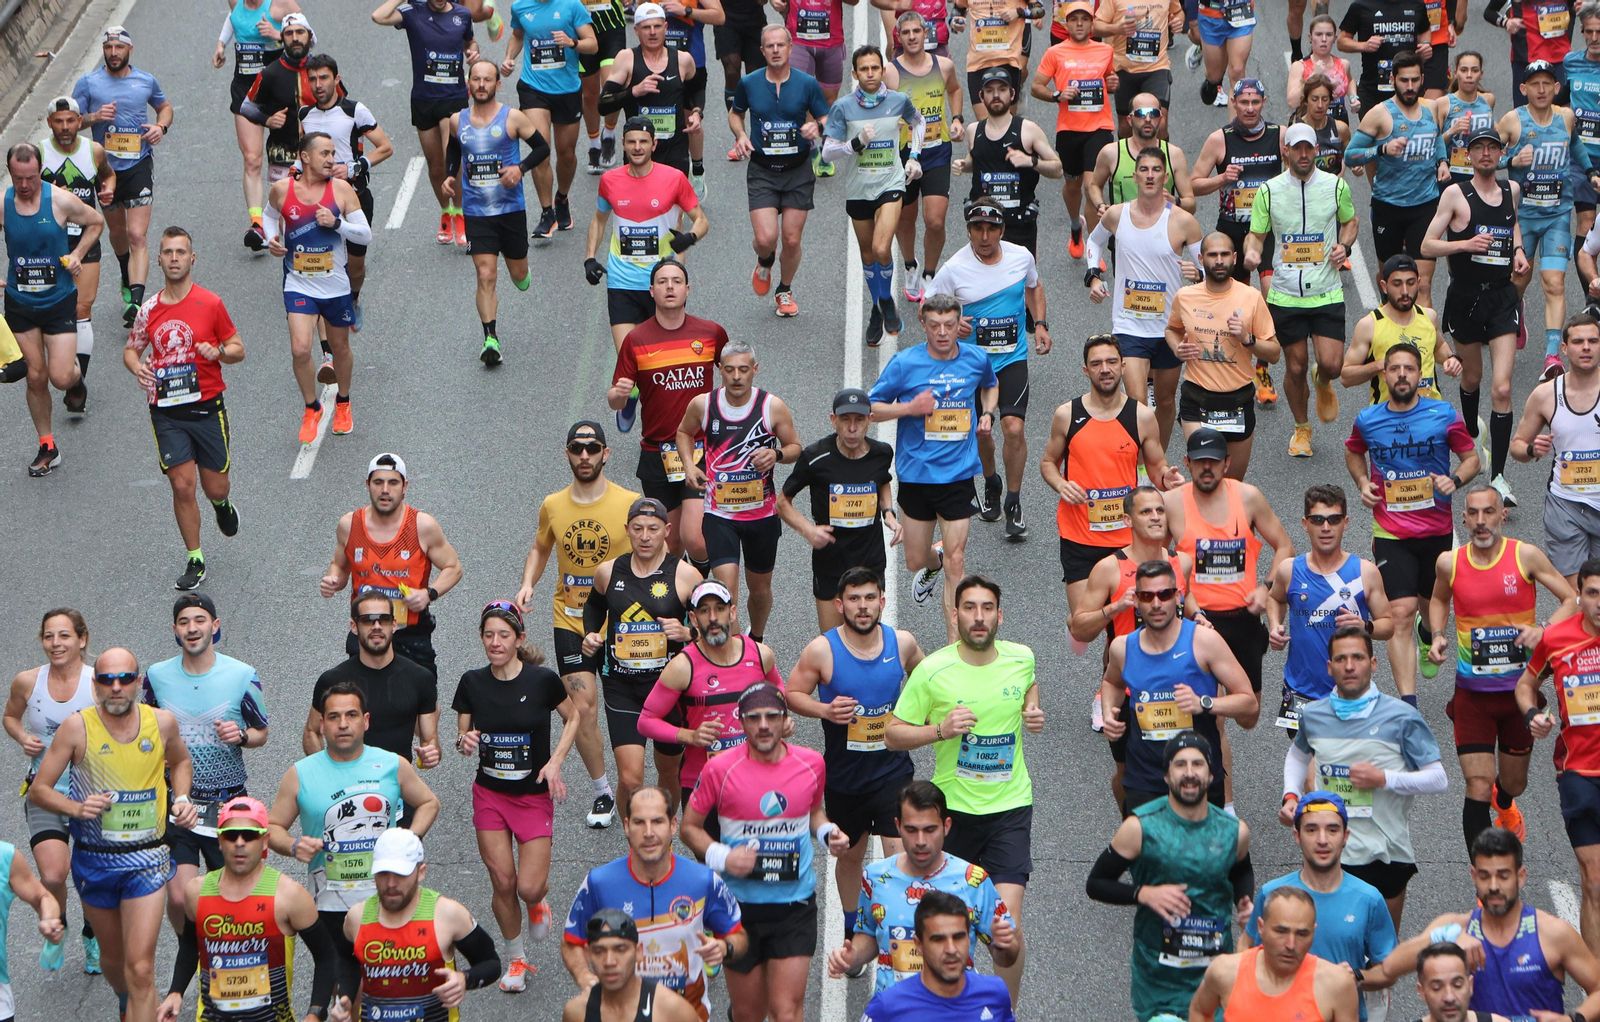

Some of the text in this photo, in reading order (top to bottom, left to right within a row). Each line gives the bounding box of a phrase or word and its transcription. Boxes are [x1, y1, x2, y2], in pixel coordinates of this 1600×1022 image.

[1547, 5, 1565, 13] ZURICH
[807, 10, 826, 18] ZURICH
[1373, 22, 1416, 33] FINISHER
[1582, 121, 1595, 129] 3419
[869, 140, 891, 148] ZURICH
[1231, 153, 1277, 164] Esenciarun
[631, 227, 655, 235] ZURICH
[1489, 227, 1511, 235] ZURICH
[631, 239, 646, 247] 3326
[1142, 304, 1157, 312] MARÍA
[990, 317, 1014, 325] ZURICH
[1194, 326, 1216, 335] Maratón
[652, 366, 704, 385] QATAR
[665, 379, 704, 390] AIRWAYS
[942, 400, 966, 408] ZURICH
[1399, 469, 1426, 479] ZURICH
[1576, 466, 1592, 474] 3737
[731, 472, 757, 481] ZURICH
[1101, 488, 1128, 498] ZURICH
[1400, 484, 1417, 493] 5363
[723, 496, 756, 504] FIFTYPOWER
[1396, 494, 1424, 502] BENJAMIN
[846, 500, 862, 508] 3747
[1213, 540, 1241, 549] ZURICH
[1213, 555, 1231, 564] 2833
[631, 623, 660, 631] ZURICH
[1489, 628, 1518, 637] ZURICH
[631, 639, 649, 647] 3955
[1489, 644, 1508, 654] 3243
[1488, 657, 1511, 665] DANIEL
[1583, 675, 1600, 684] ZUR
[1153, 692, 1176, 700] ZURIC
[868, 703, 892, 715] ZURICH
[1154, 708, 1172, 716] 3671
[867, 721, 884, 731] 3660
[1153, 721, 1177, 729] SANTOS
[493, 735, 524, 743] ZURICH
[725, 737, 747, 747] ZURIC
[980, 736, 1010, 745] ZURICH
[494, 750, 512, 759] 2985
[976, 751, 999, 760] 10822
[494, 762, 515, 770] ALEIXO
[1334, 784, 1352, 793] 1832
[122, 792, 152, 802] ZURICH
[122, 809, 140, 818] 1474
[122, 822, 139, 830] PEPE
[764, 841, 795, 850] ZURICH
[343, 859, 363, 868] 1576
[762, 858, 782, 870] 3409
[763, 872, 780, 882] JOTA
[203, 915, 265, 938] Gorras
[205, 937, 270, 953] runners
[364, 940, 426, 963] Gorras
[225, 956, 261, 966] ZURICH
[363, 962, 430, 978] runners
[227, 975, 248, 985] 5730
[221, 990, 241, 998] MANU
[382, 1008, 417, 1018] ZURICH
